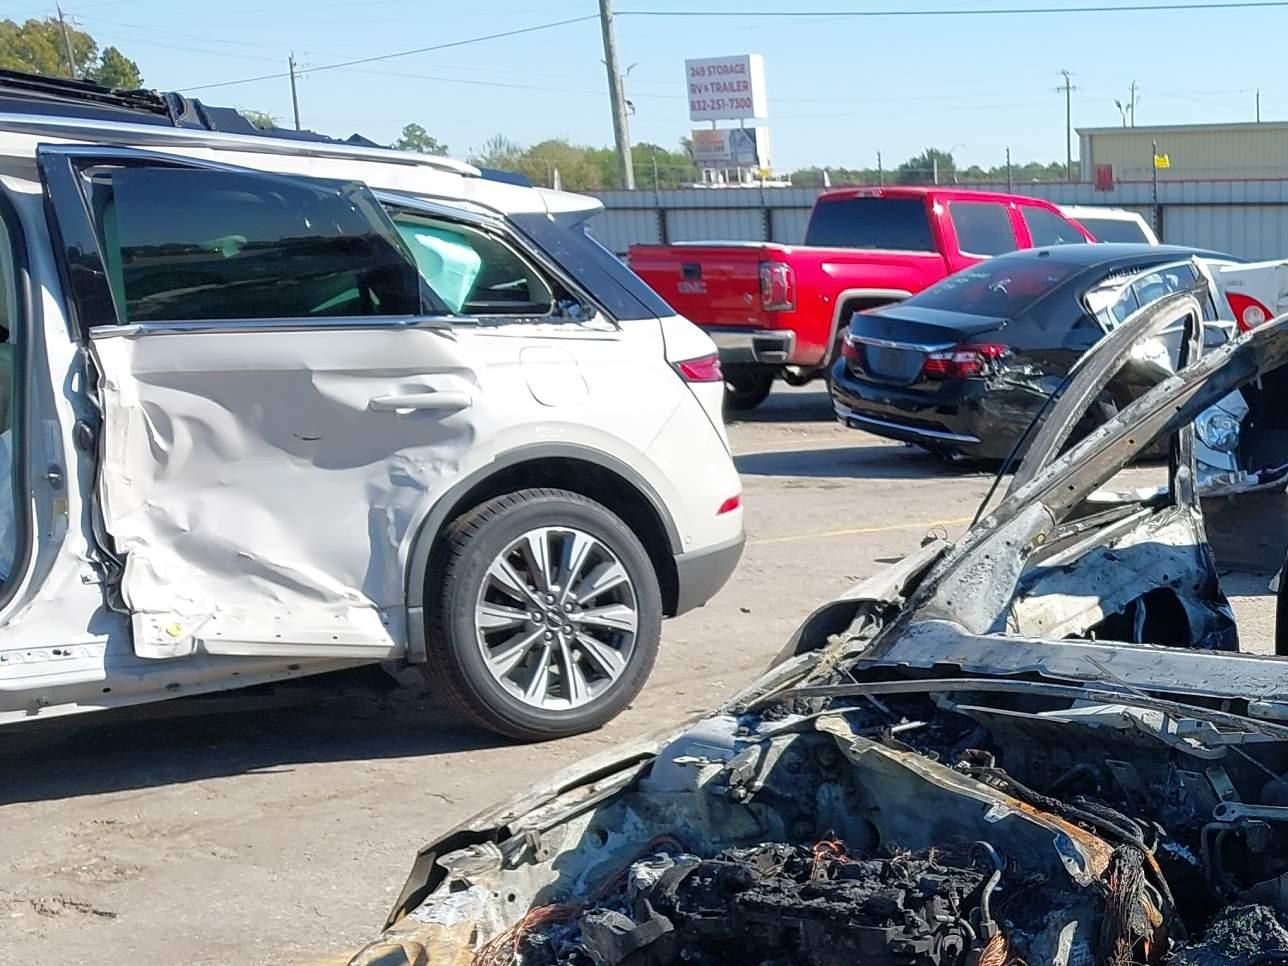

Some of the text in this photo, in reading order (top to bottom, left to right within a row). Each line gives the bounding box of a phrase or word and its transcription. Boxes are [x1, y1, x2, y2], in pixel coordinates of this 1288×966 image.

[690, 64, 746, 77] 249 STORAGE
[690, 83, 703, 94] RV
[710, 80, 749, 93] TRAILER
[690, 97, 752, 112] 832-251-7300
